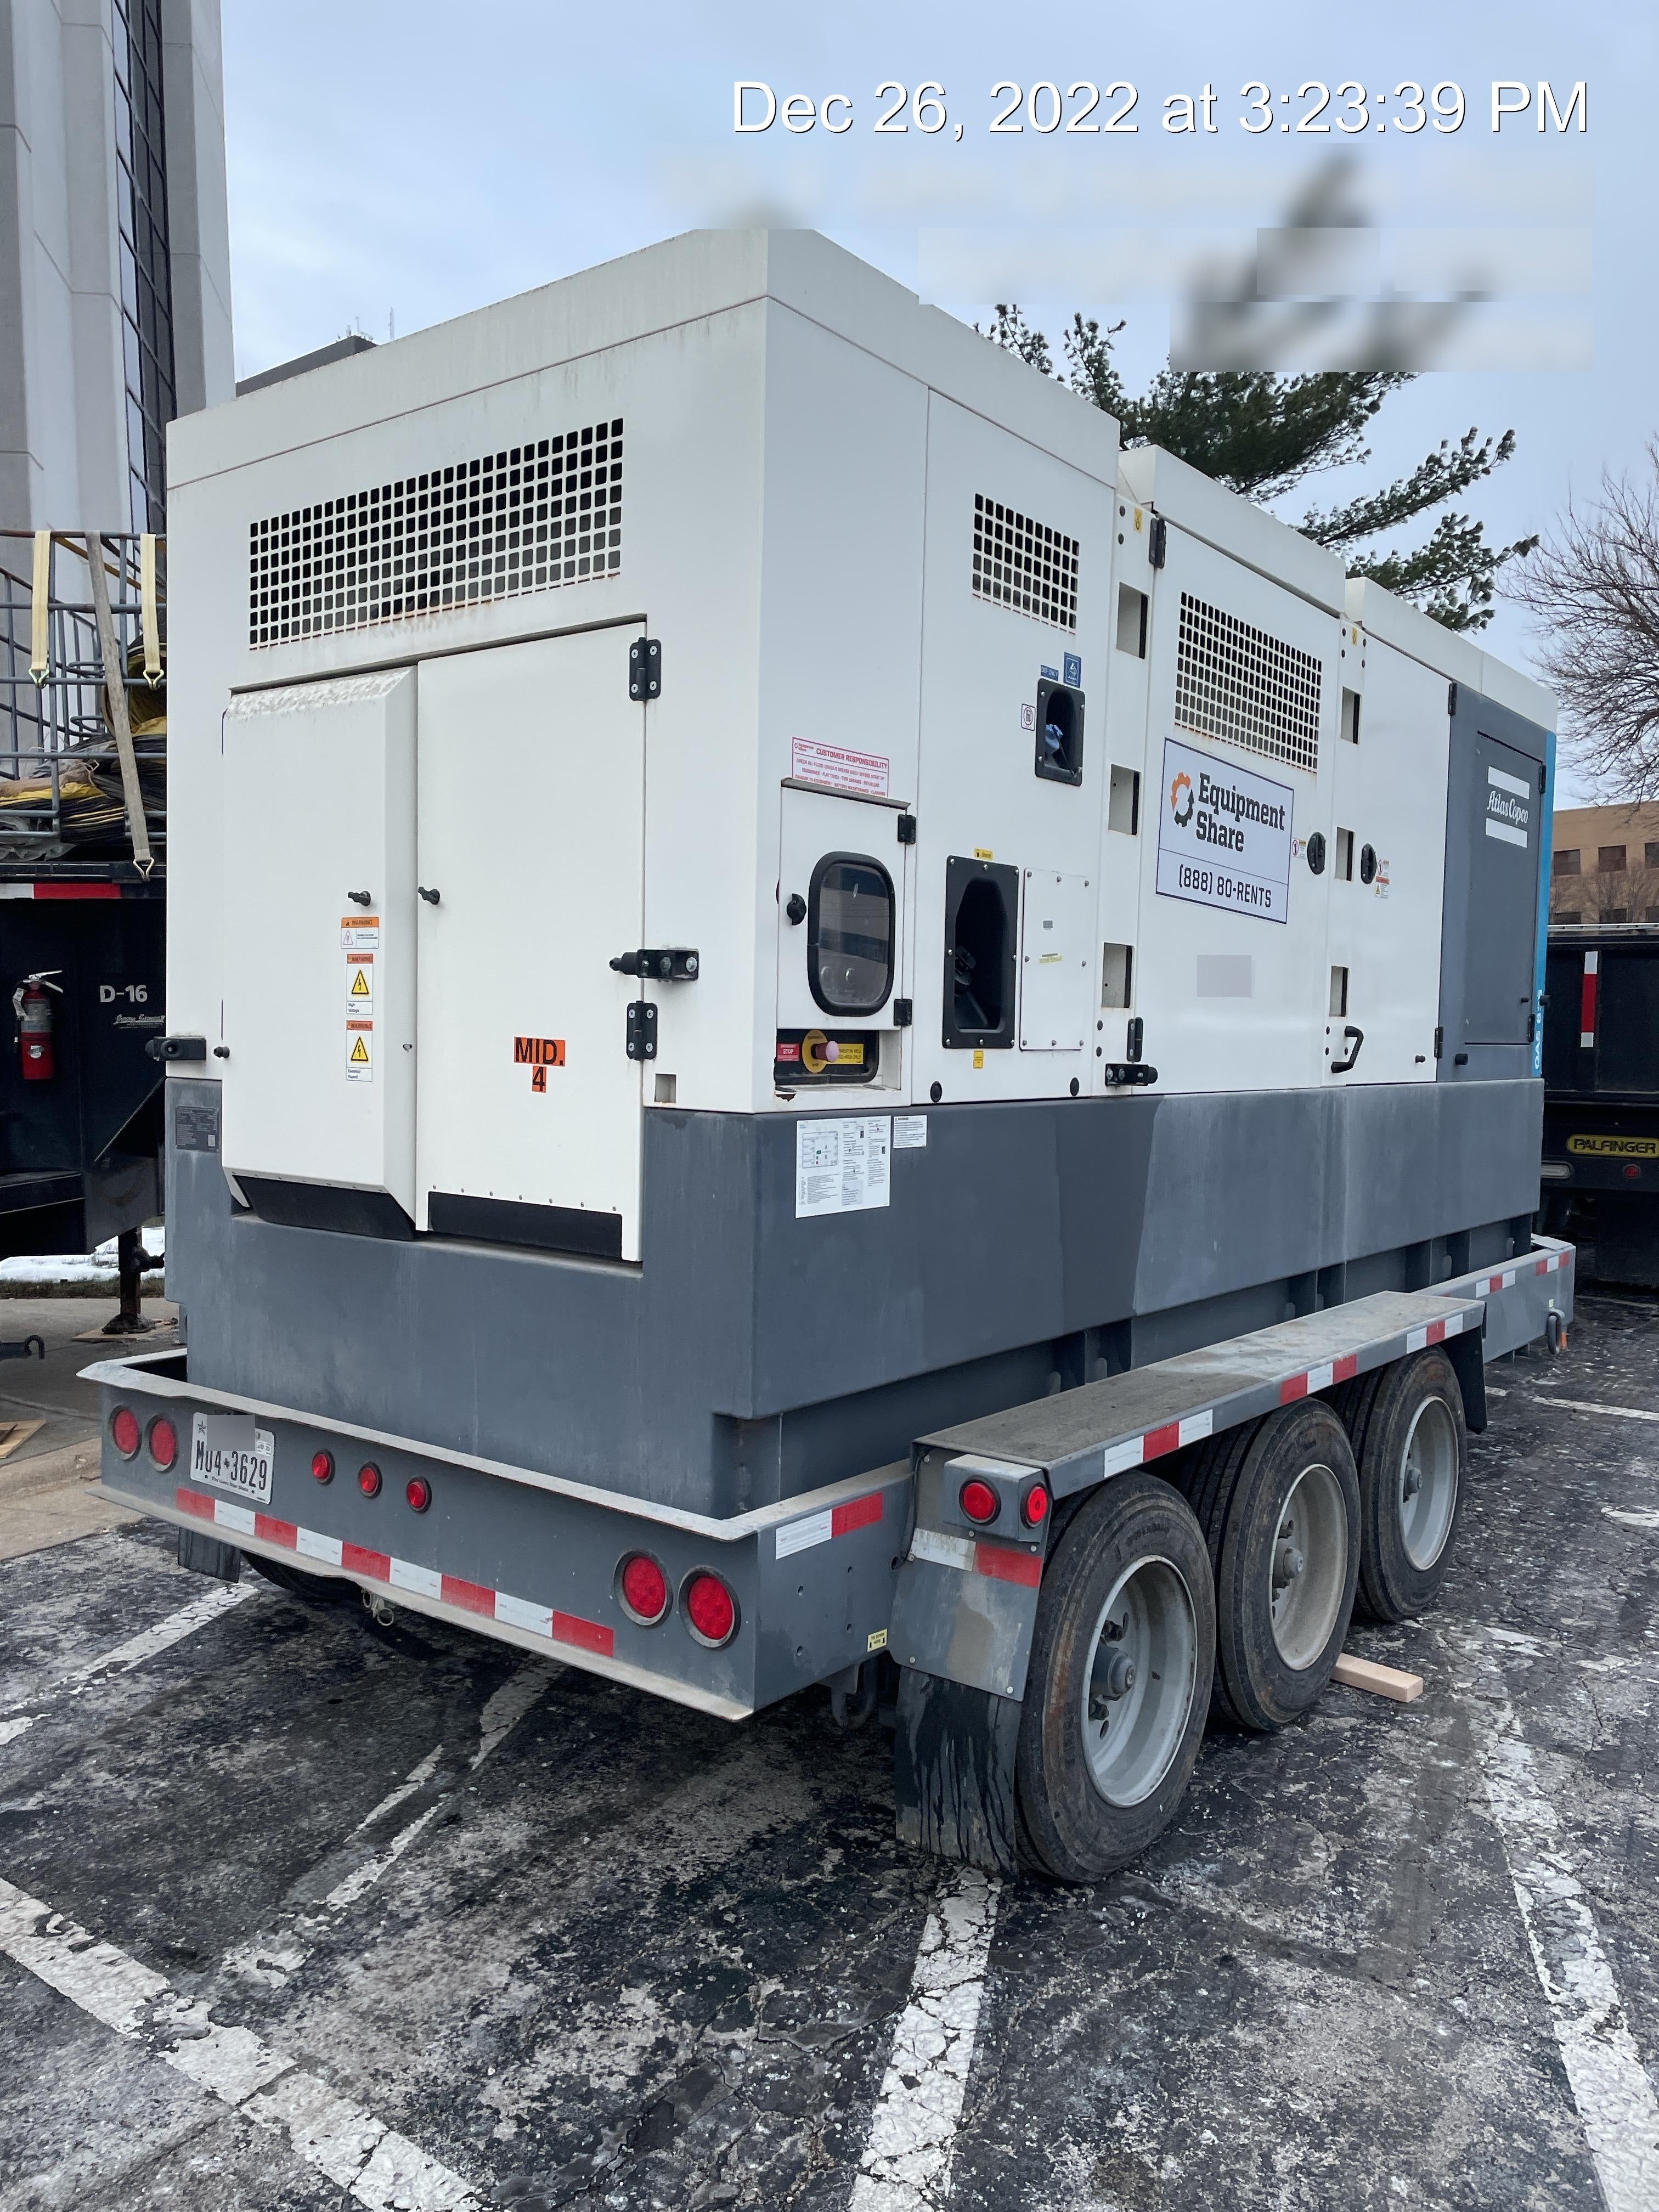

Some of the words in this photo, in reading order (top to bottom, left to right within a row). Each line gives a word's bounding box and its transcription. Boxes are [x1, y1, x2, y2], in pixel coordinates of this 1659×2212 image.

[817, 748, 844, 760] CUSTOMER
[845, 754, 888, 769] RESPONSIBILITY
[1198, 772, 1286, 831] Equipment
[1487, 790, 1509, 817] Atlas
[1509, 798, 1528, 825] Copco
[1196, 810, 1245, 852] Share
[1179, 864, 1213, 894] (888)
[1217, 876, 1272, 908] 80-RENTS
[100, 985, 148, 1003] D-16
[516, 1037, 564, 1065] MID.
[532, 1066, 545, 1092] 4
[1574, 1138, 1656, 1154] PALFINGER
[230, 1451, 267, 1490] 3629
